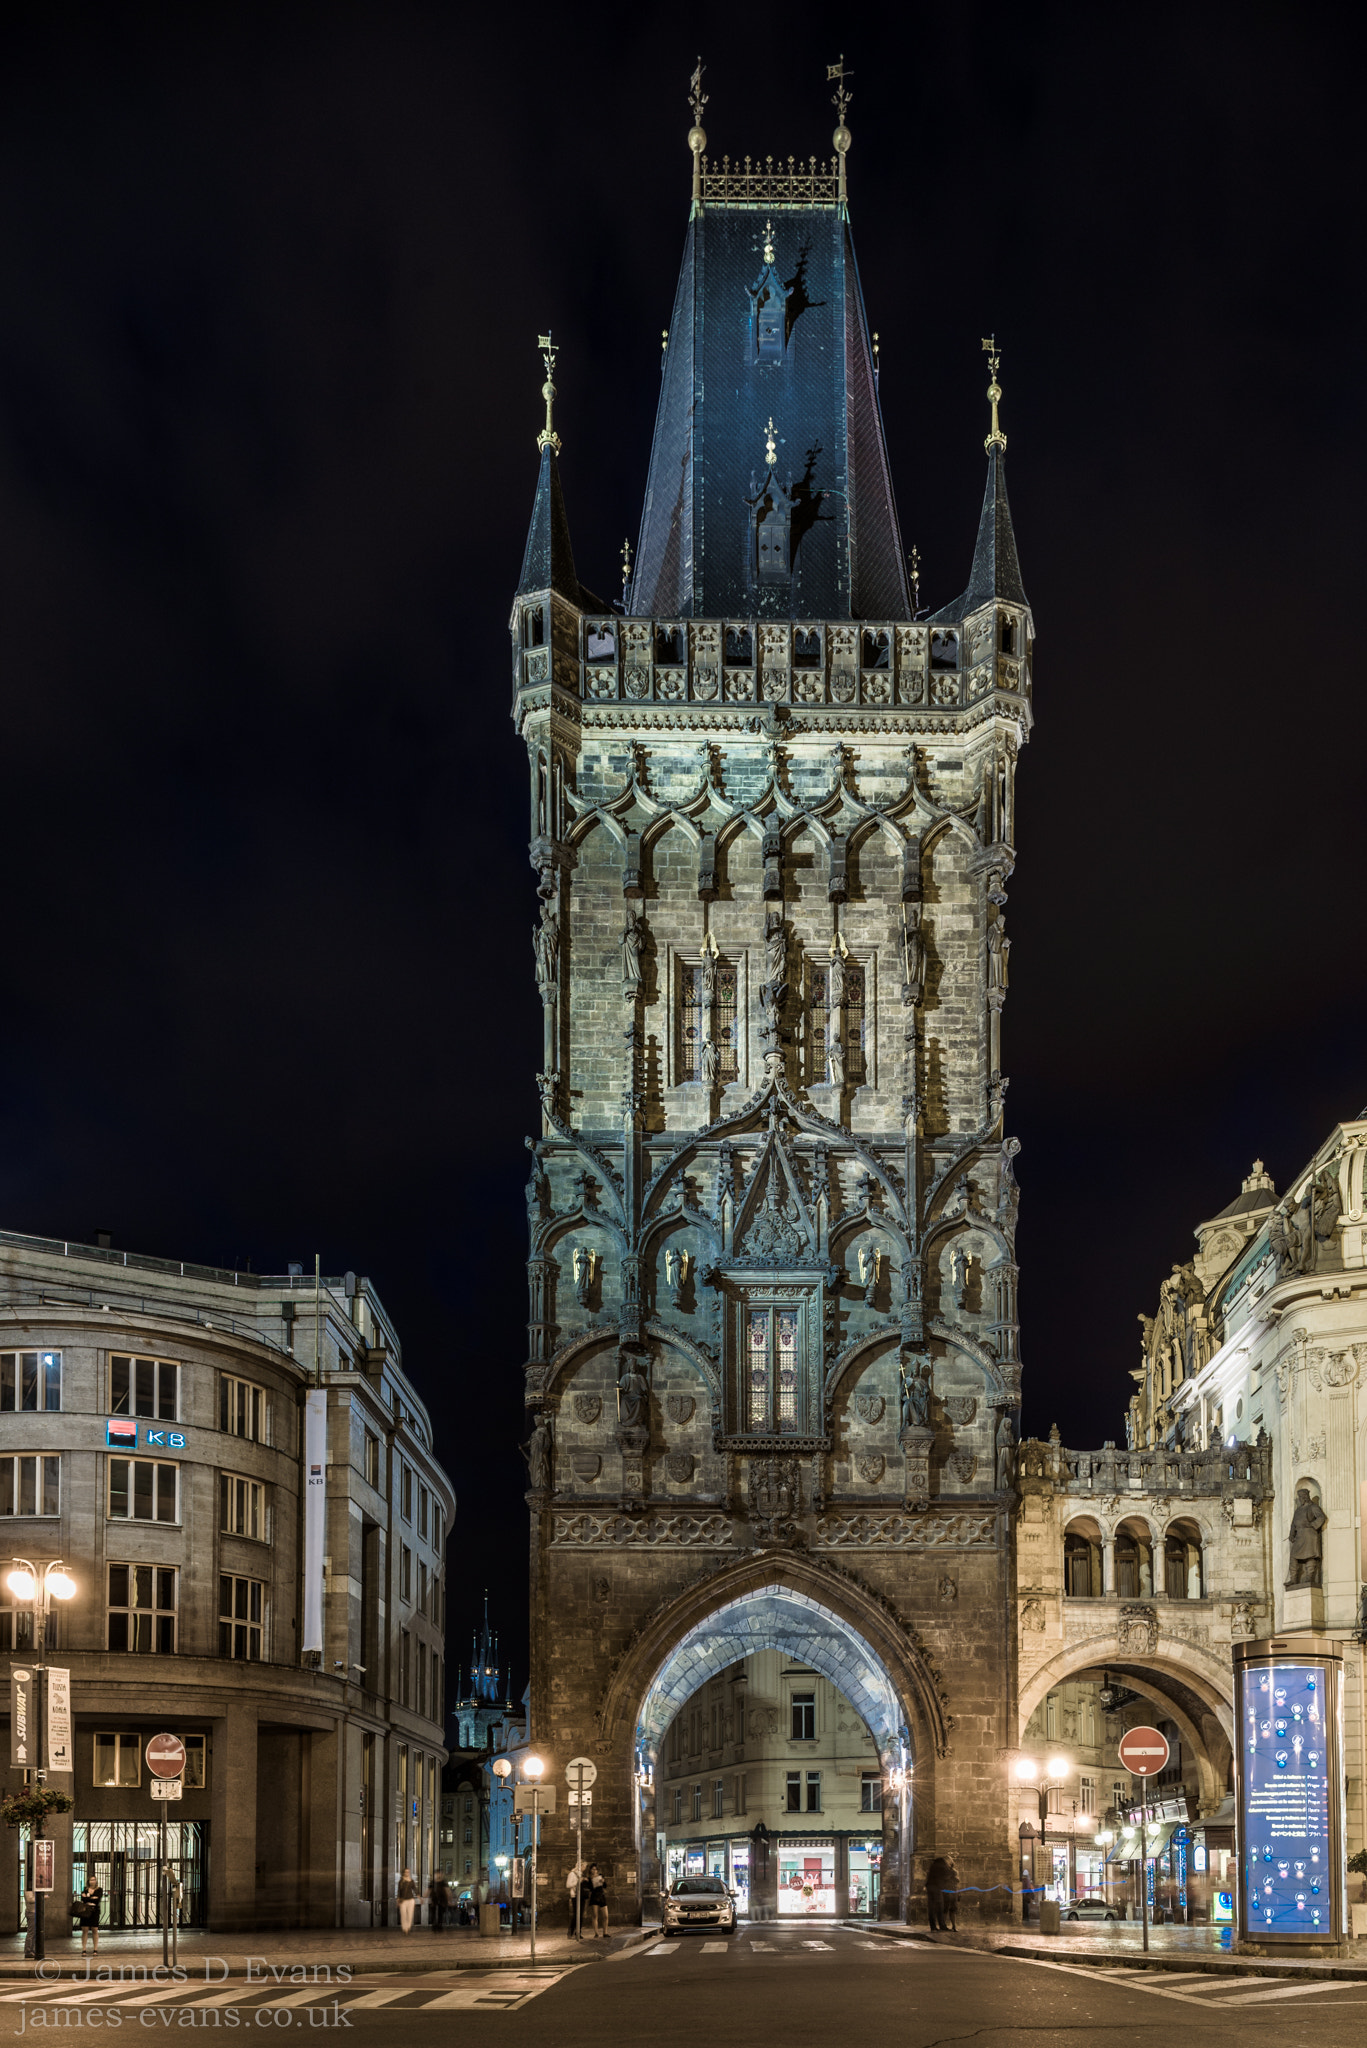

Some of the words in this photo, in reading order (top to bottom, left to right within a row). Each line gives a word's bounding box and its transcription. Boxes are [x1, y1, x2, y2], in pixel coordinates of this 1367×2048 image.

[147, 1430, 185, 1448] KB
[308, 1478, 324, 1486] KB
[16, 1684, 27, 1742] SUBWAY
